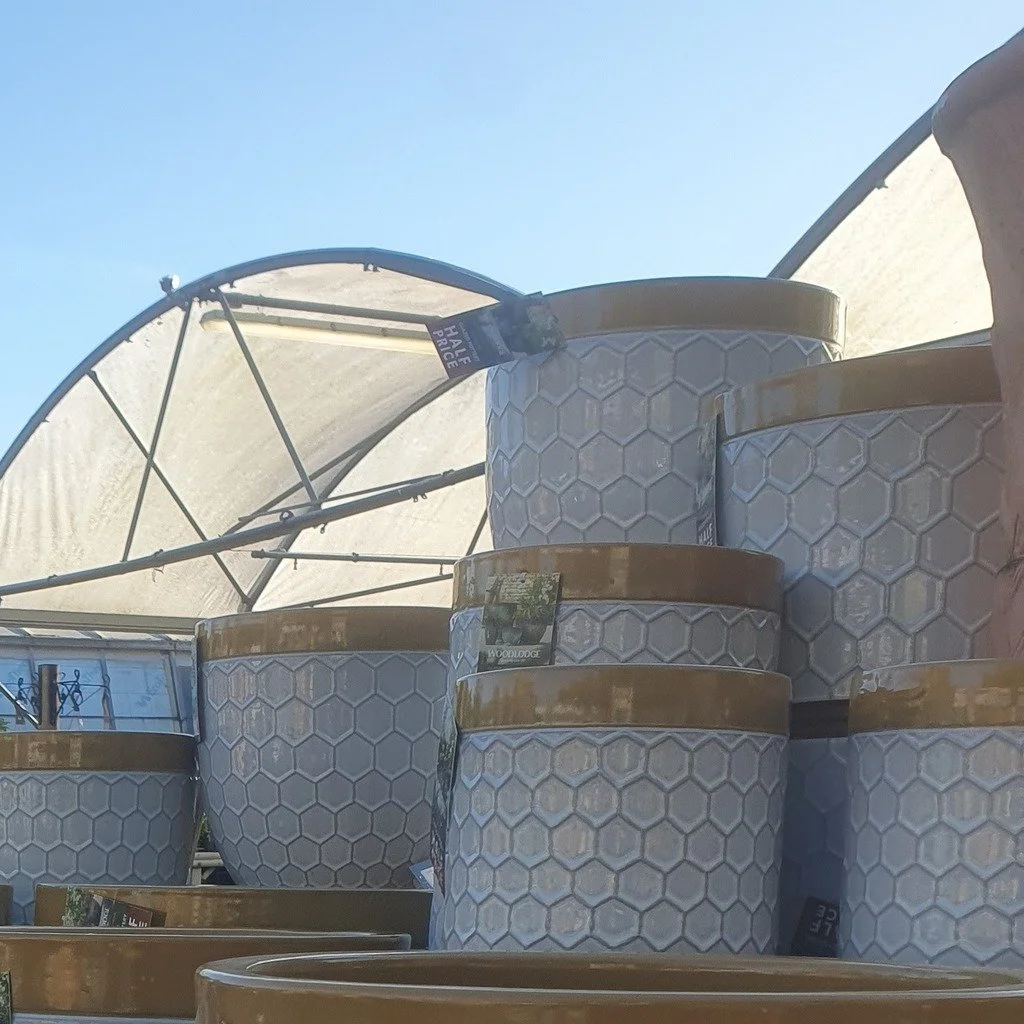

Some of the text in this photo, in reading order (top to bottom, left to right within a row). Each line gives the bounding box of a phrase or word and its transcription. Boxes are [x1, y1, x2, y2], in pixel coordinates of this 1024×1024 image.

[433, 329, 459, 369] PRICE
[444, 325, 471, 366] HALF
[488, 649, 541, 659] WOODLODGE
